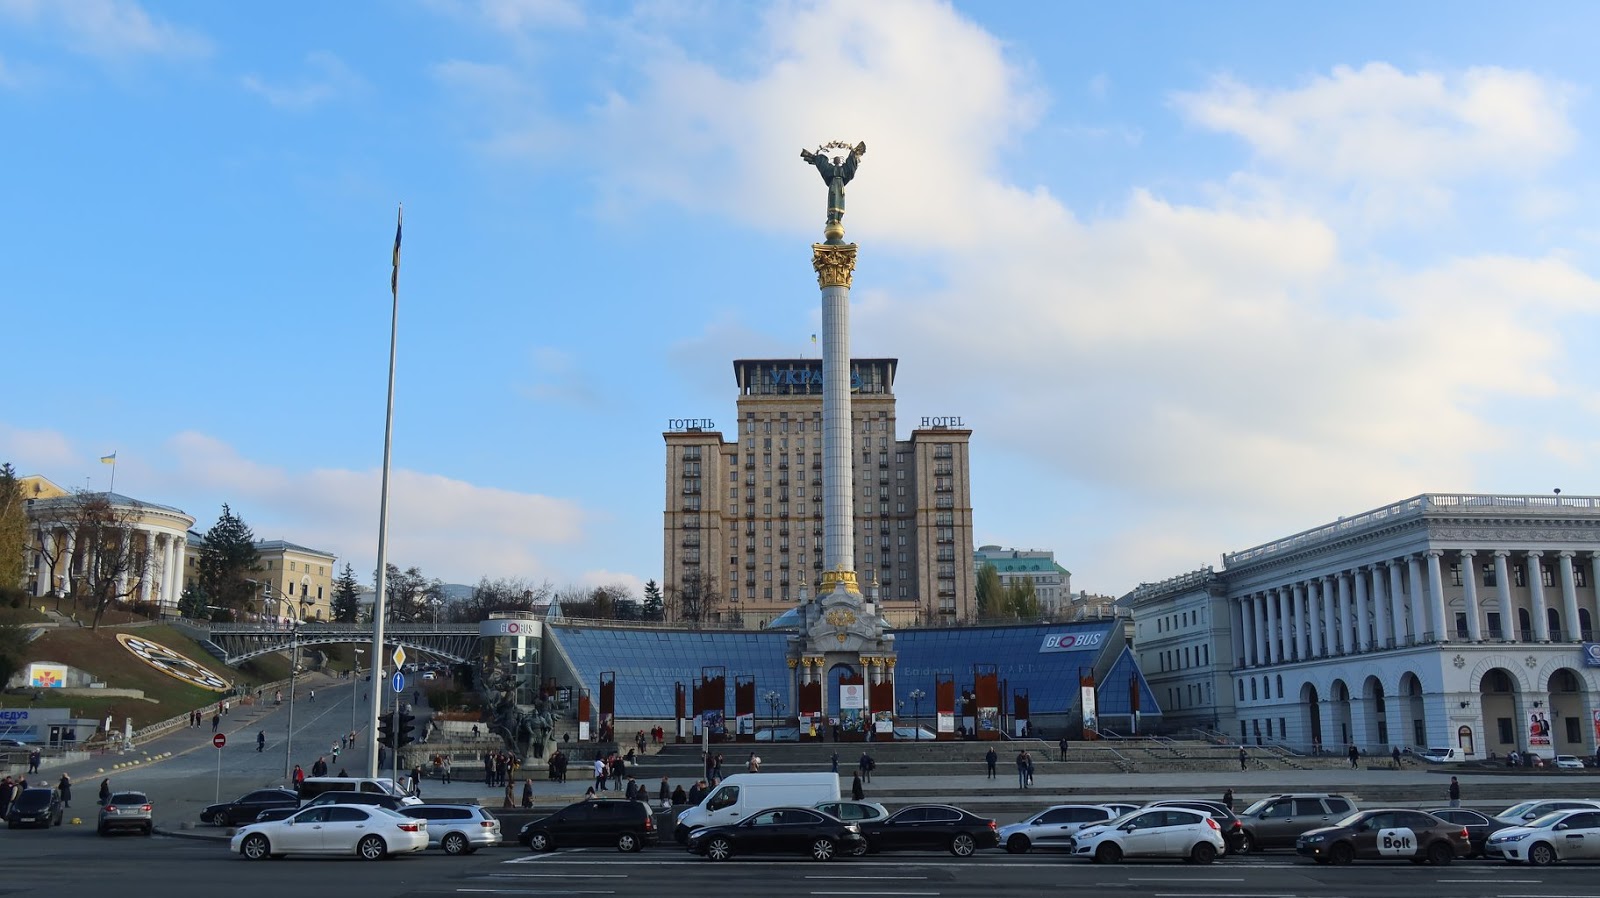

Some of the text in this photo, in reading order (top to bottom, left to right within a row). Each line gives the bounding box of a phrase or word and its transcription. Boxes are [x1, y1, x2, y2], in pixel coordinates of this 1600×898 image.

[668, 418, 715, 429] ГОТЕЛЬ
[921, 416, 965, 427] HOTEL
[500, 622, 533, 634] GLOBUS
[1046, 633, 1101, 649] GLOBUS
[1383, 836, 1411, 849] Bolt
